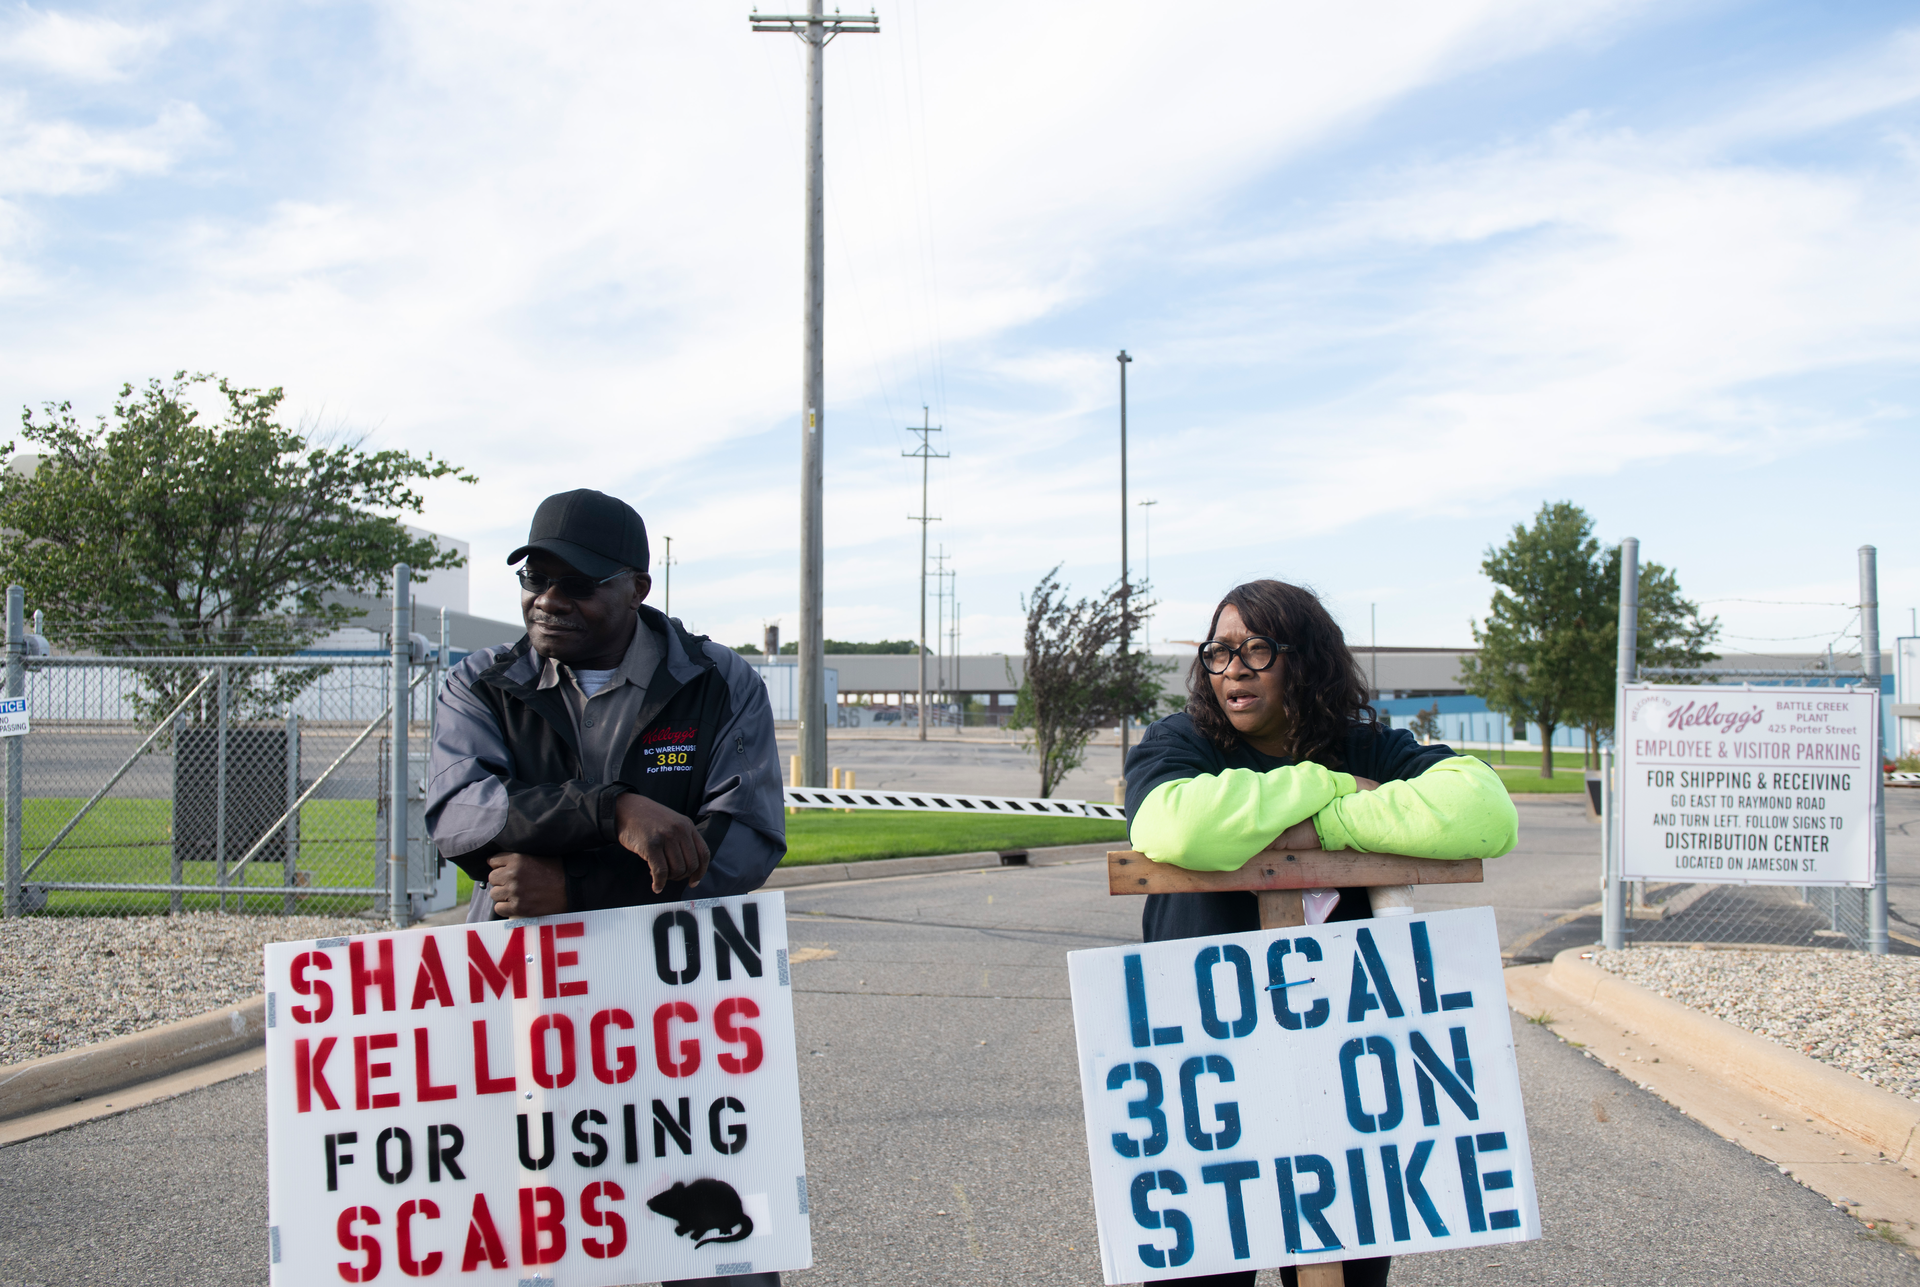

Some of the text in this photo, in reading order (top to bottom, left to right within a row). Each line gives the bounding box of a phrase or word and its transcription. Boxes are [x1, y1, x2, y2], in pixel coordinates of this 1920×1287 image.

[0, 701, 24, 712] TICE
[1631, 696, 1659, 722] WELCOME
[1776, 701, 1849, 711] BATTLE CREEK
[1667, 700, 1764, 734] Kellogg's
[1796, 713, 1829, 722] PLANT
[642, 726, 698, 745] Kellogg's
[1768, 724, 1857, 735] 425 Porter Street
[643, 744, 697, 756] BC WAREHOUSE
[656, 752, 688, 766] 380
[1636, 739, 1861, 761] EMPLOYEE & VISITOR PARKING
[646, 766, 660, 774] For
[1647, 770, 1851, 791] FOR SHIPPING & RECEIVING
[1671, 794, 1826, 810] GO EAST TO RAYMOND ROAD
[1653, 813, 1843, 830] AND TURN LEFT. FOLLOW SIGNS TO
[1665, 832, 1829, 852] DISTRIBUTION CENTER
[1676, 855, 1817, 872] LOCATED ON JAMESON ST.
[290, 903, 763, 1025] SHAME ON
[1123, 920, 1474, 1048] LOCAL
[294, 997, 765, 1114] KELLOGGS
[1106, 1026, 1480, 1158] 3G ON
[324, 1096, 748, 1192] FOR USING
[1130, 1131, 1521, 1269] STRIKE
[336, 1180, 628, 1283] SCABS
